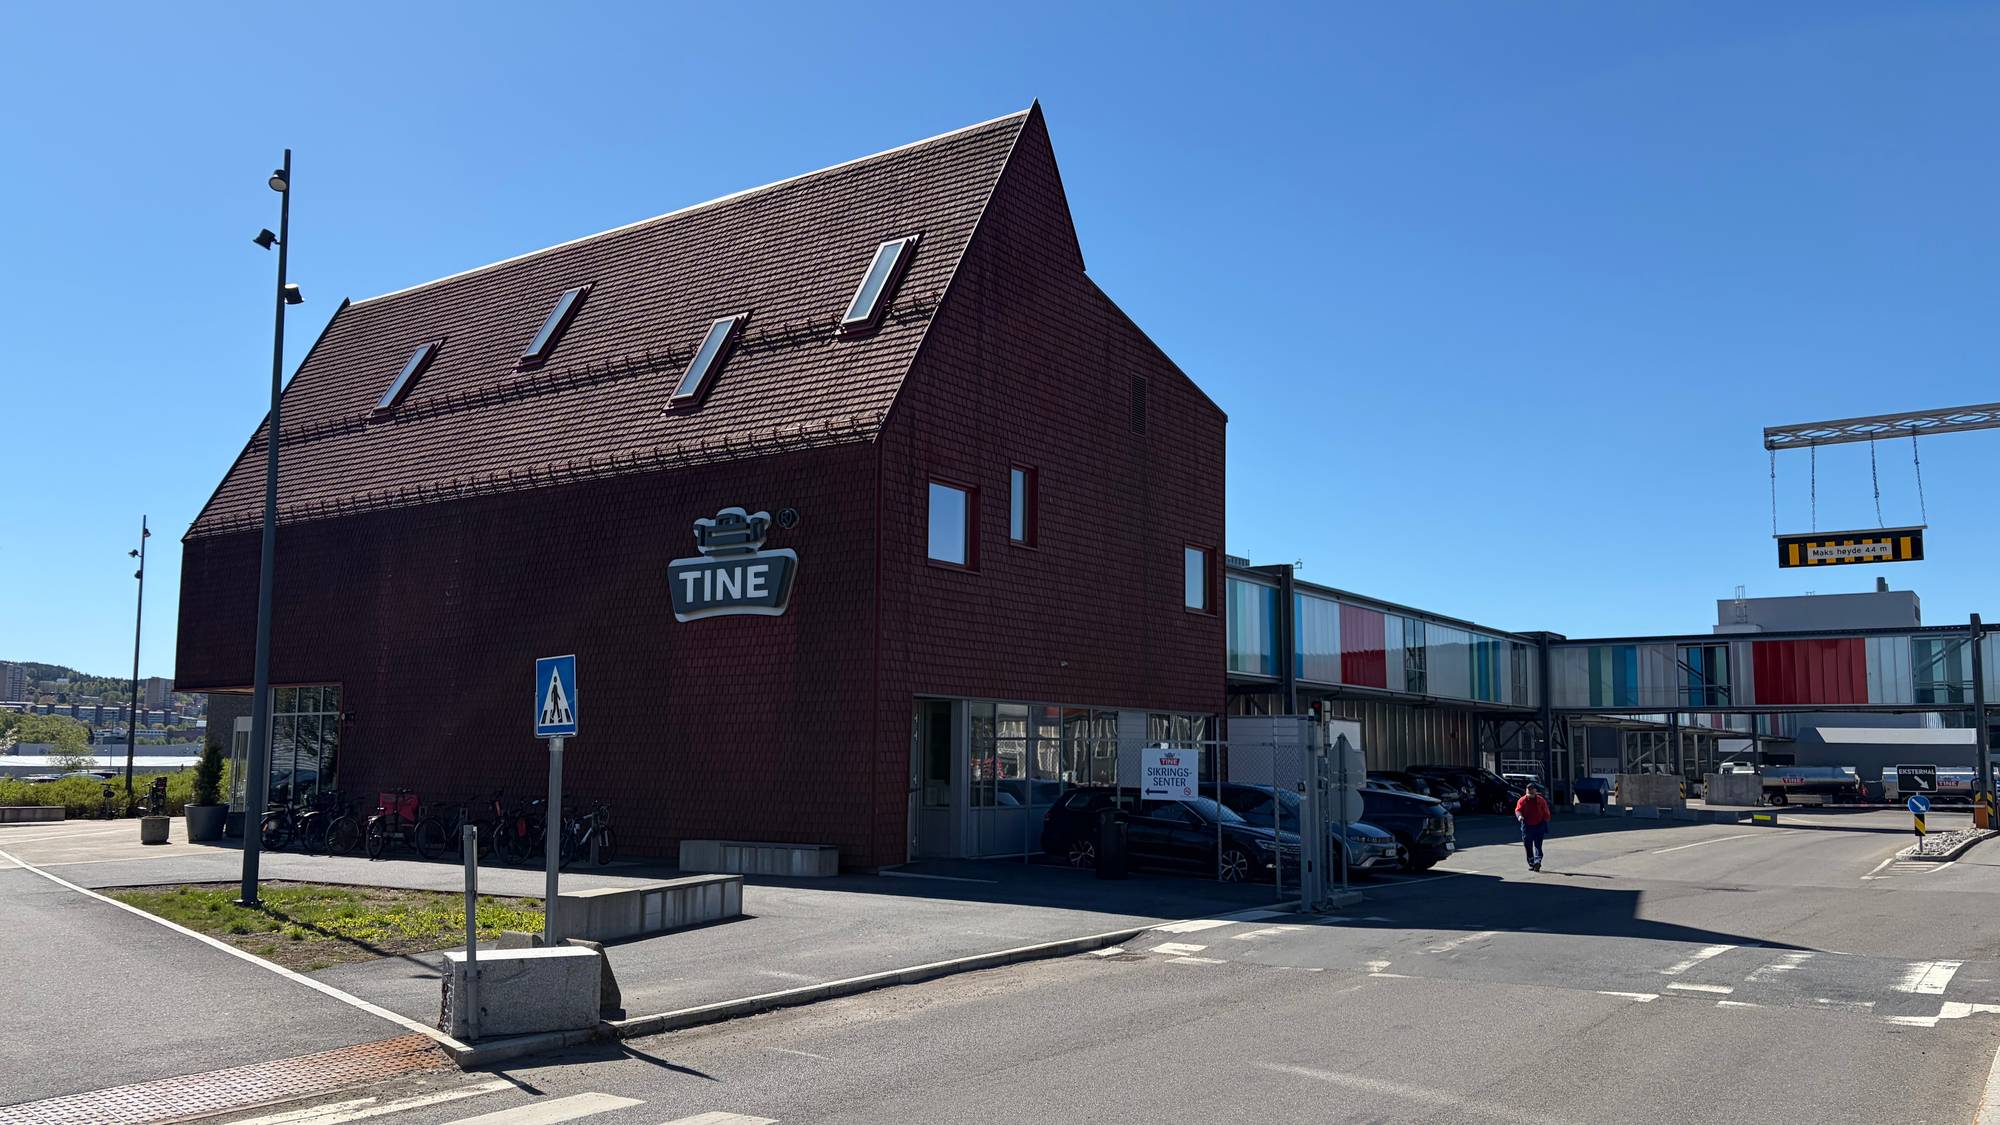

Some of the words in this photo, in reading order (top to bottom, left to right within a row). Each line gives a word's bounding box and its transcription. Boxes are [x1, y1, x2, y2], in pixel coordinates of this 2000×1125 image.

[1813, 548, 1833, 556] Maks
[678, 564, 769, 603] TINE
[1147, 767, 1192, 777] SIKRINGS-
[1153, 777, 1186, 787] SENTER
